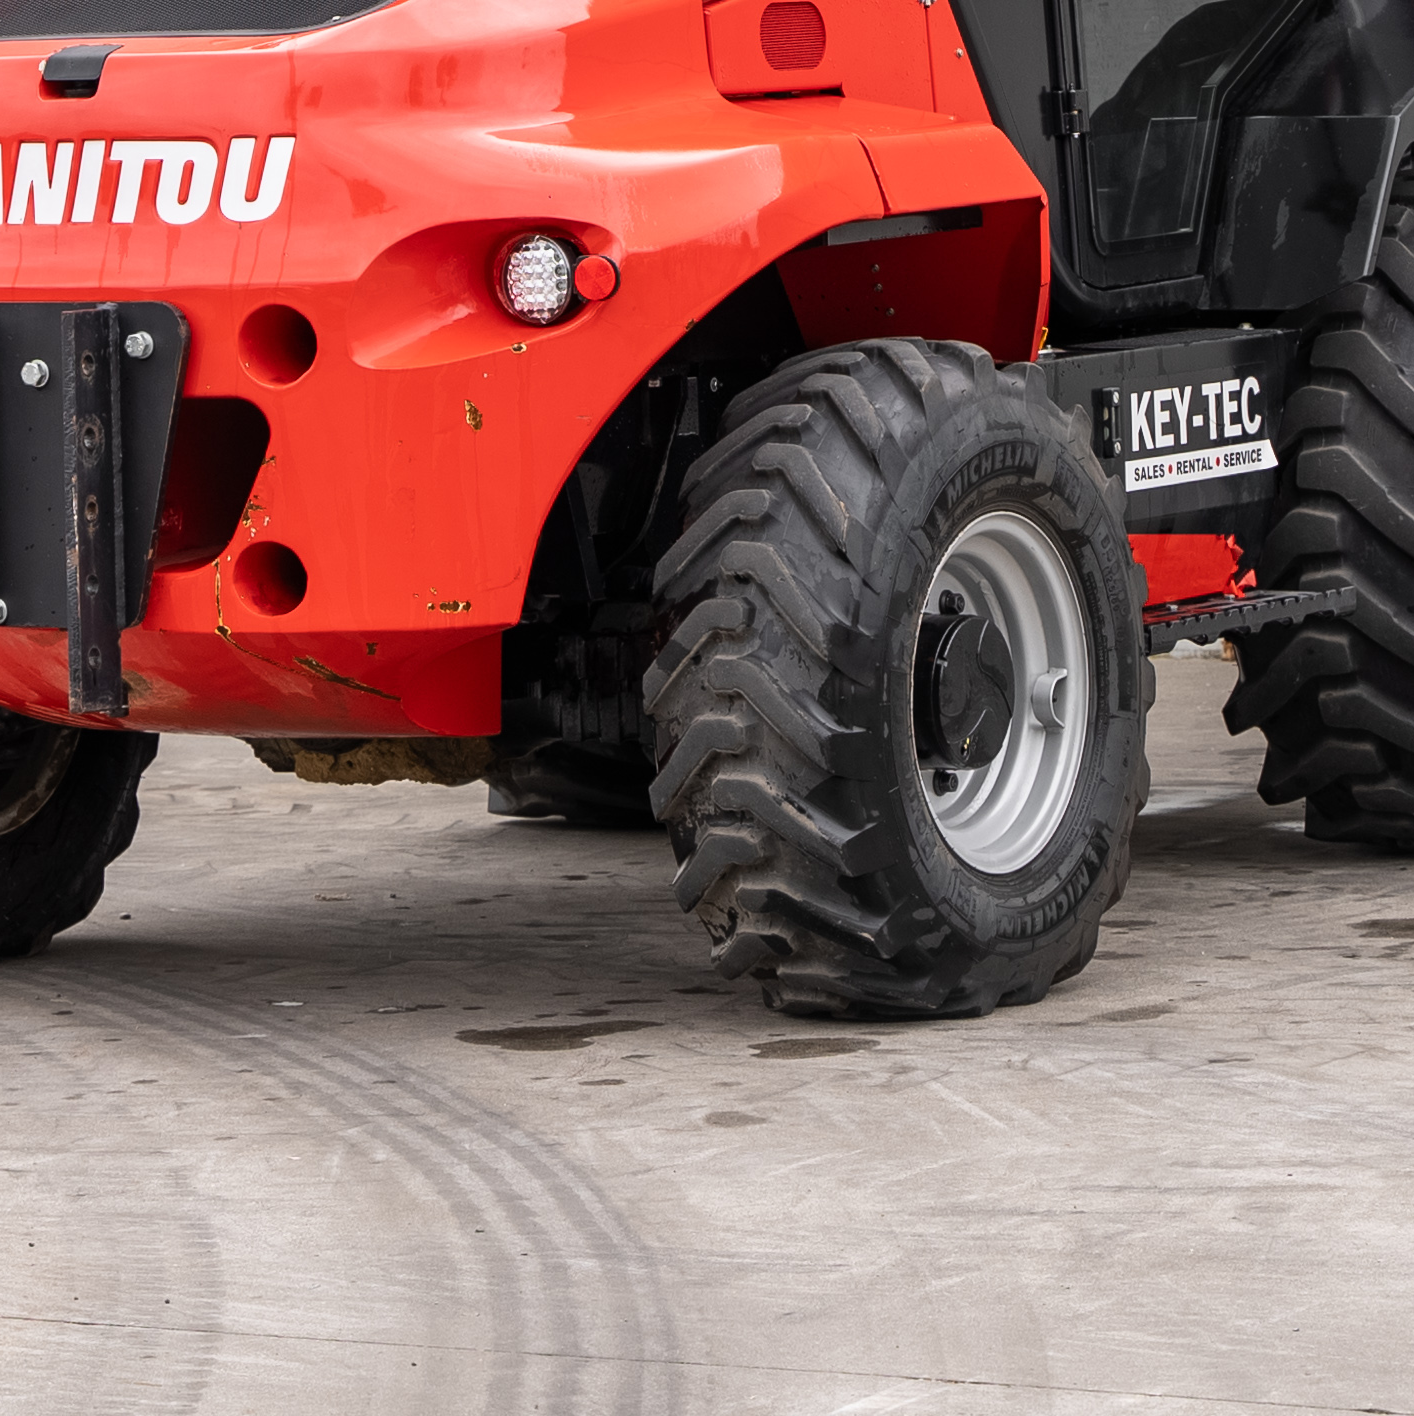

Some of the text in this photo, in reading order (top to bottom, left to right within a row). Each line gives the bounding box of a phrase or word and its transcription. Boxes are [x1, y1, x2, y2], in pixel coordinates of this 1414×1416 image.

[1130, 376, 1262, 452] KEY-TEC
[946, 443, 1038, 509] MICHELIN
[1134, 448, 1262, 482] SALES RENTAL SERVICE
[997, 863, 1090, 937] MICHELIN
